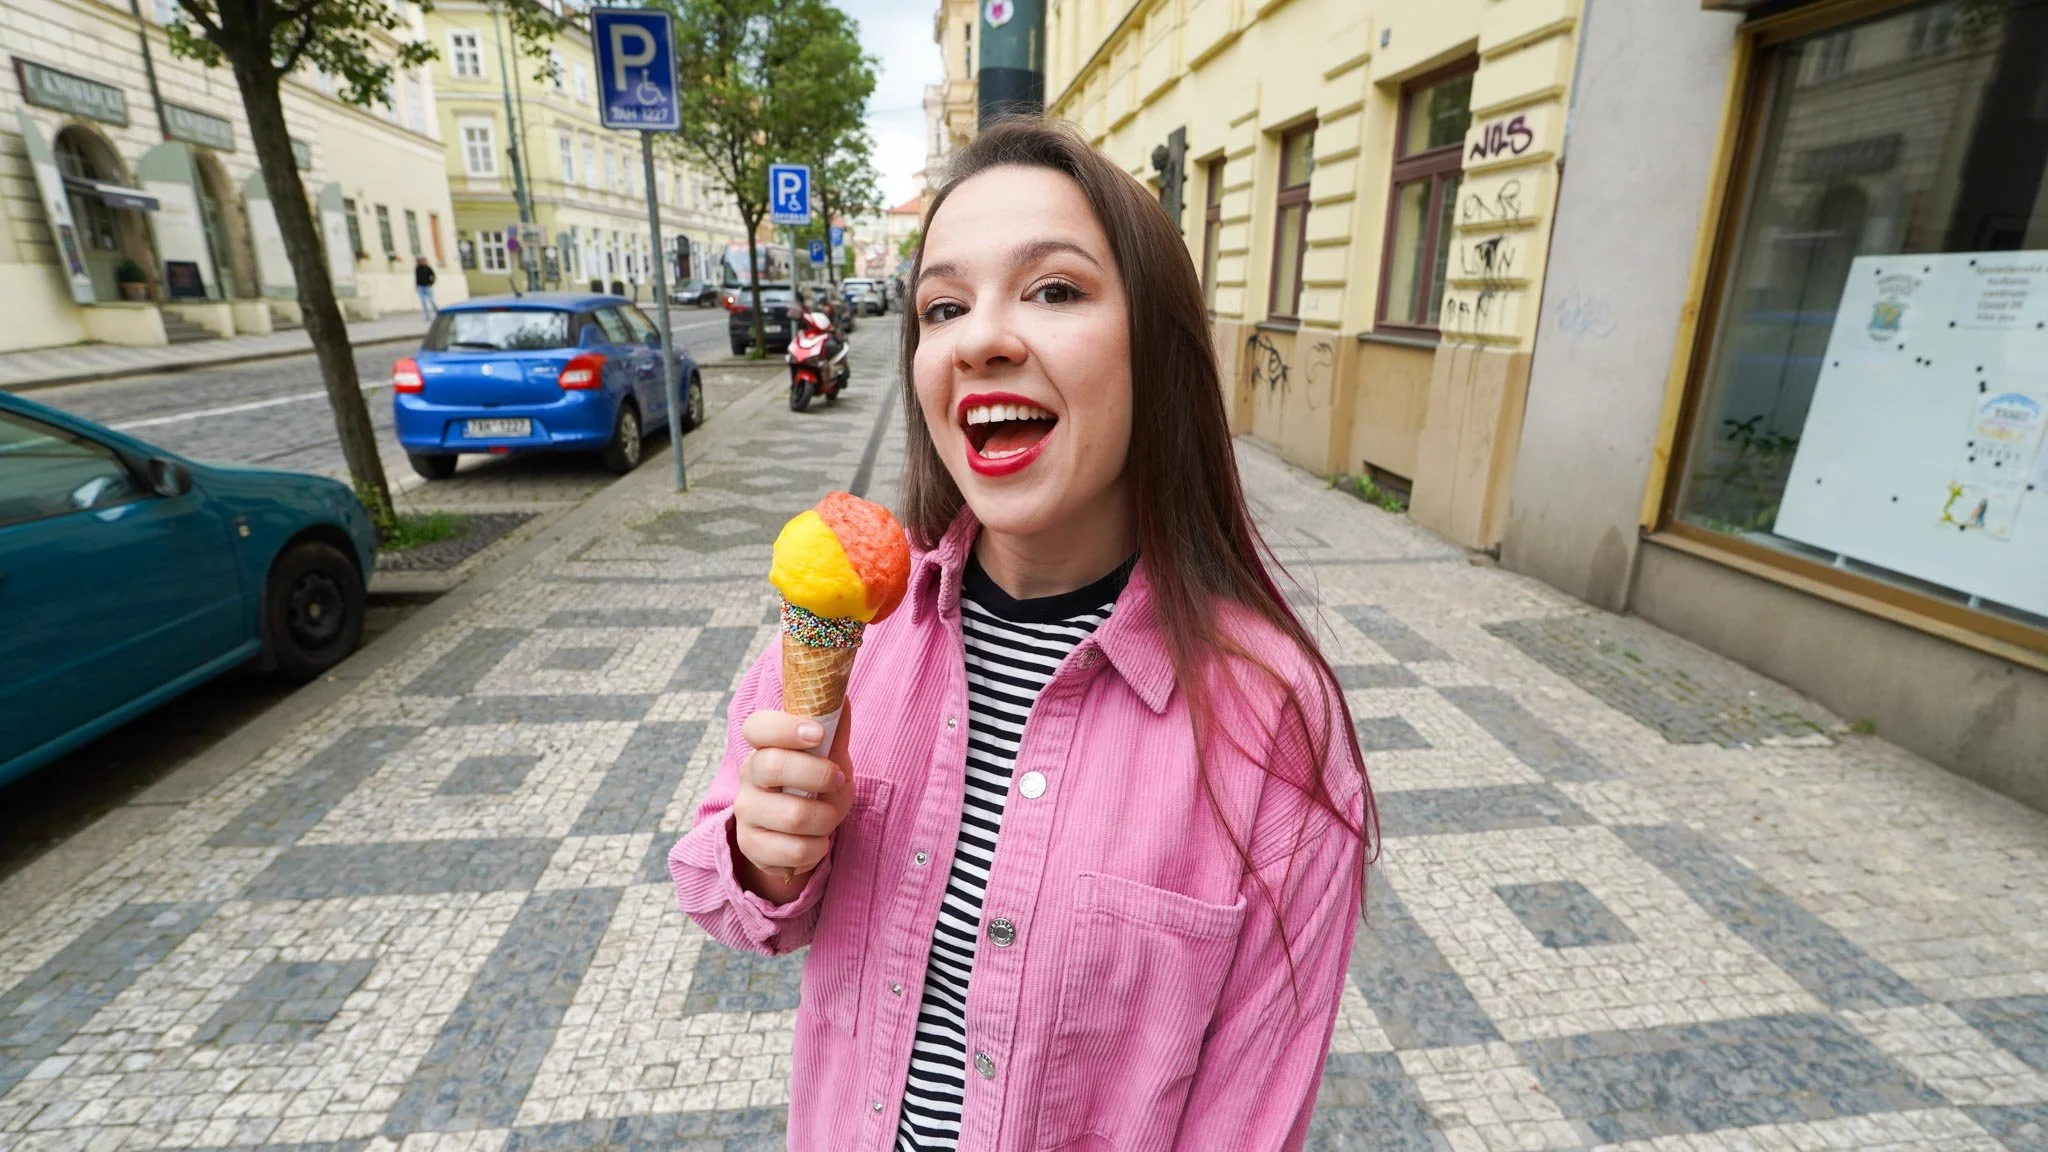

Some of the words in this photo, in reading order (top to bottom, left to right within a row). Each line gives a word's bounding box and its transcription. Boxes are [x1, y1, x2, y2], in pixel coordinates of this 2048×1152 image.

[609, 23, 656, 91] P
[642, 107, 668, 121] 1227
[778, 172, 802, 206] P
